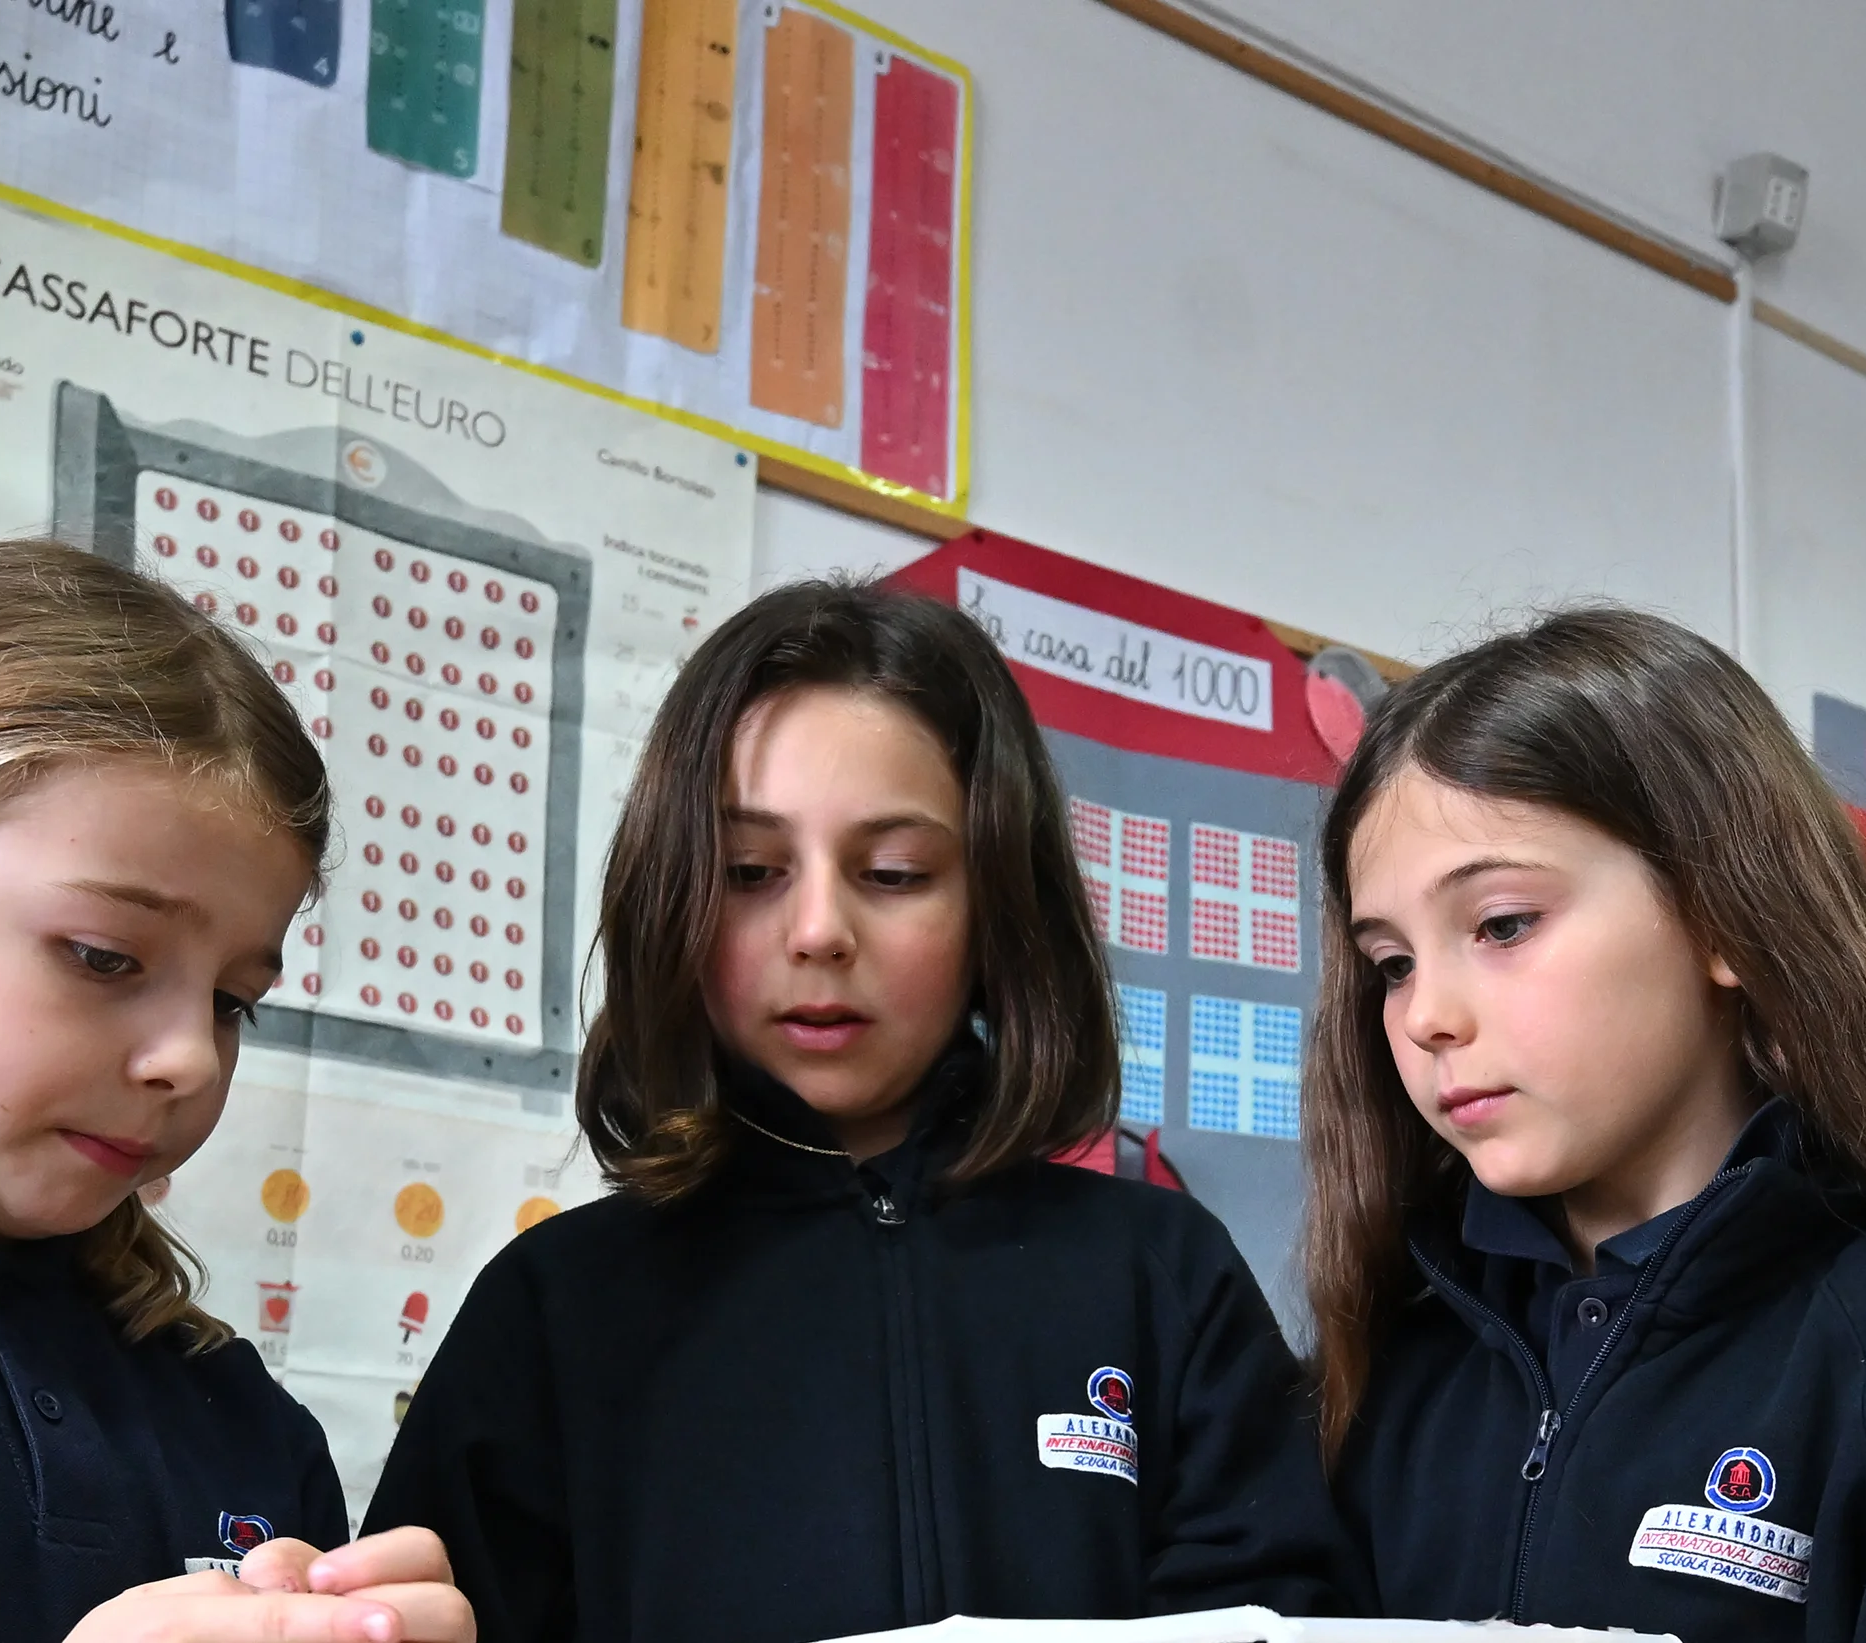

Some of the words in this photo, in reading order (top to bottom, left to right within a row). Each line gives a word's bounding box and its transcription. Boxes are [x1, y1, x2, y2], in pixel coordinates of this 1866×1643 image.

[153, 30, 180, 65] e
[286, 349, 507, 448] DELL'EURO
[1024, 629, 1095, 673] casa
[1104, 632, 1151, 690] del
[1171, 652, 1259, 717] 1000
[1074, 1455, 1117, 1471] SCUOLA
[1662, 1510, 1796, 1554] ALEXANDRIA
[1638, 1533, 1753, 1564] INTERNATIONAL
[1758, 1555, 1810, 1581] SCHOOL
[1657, 1552, 1708, 1572] SCUOLA
[1710, 1562, 1780, 1592] PARITARIA
